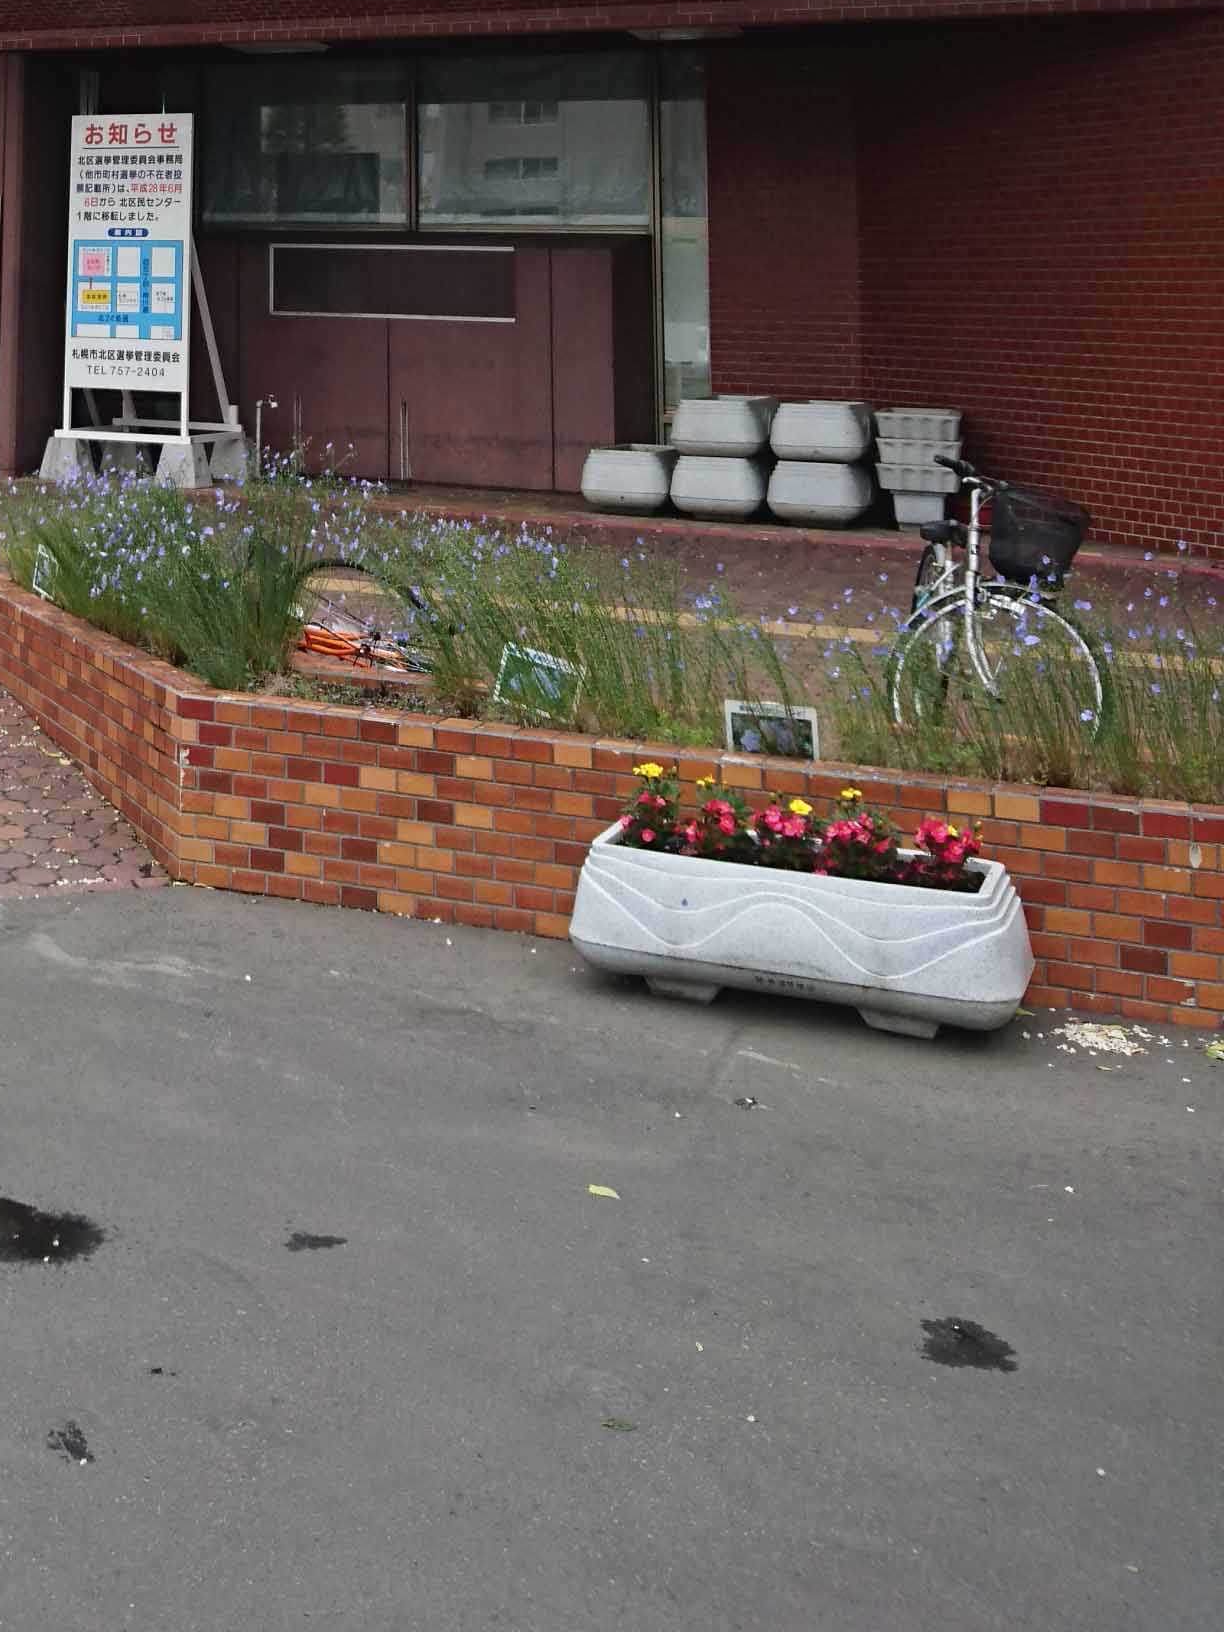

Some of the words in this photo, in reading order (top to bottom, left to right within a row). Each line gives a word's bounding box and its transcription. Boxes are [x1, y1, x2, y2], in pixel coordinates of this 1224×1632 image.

[84, 122, 178, 145] お知らせ
[77, 154, 183, 166] 北区選挙管理委員会事務局
[119, 197, 182, 207] 北区民センター
[72, 348, 181, 363] 札幌市北区選挙管理委員会
[87, 365, 107, 375] TEL
[111, 366, 166, 377] 757-2404
